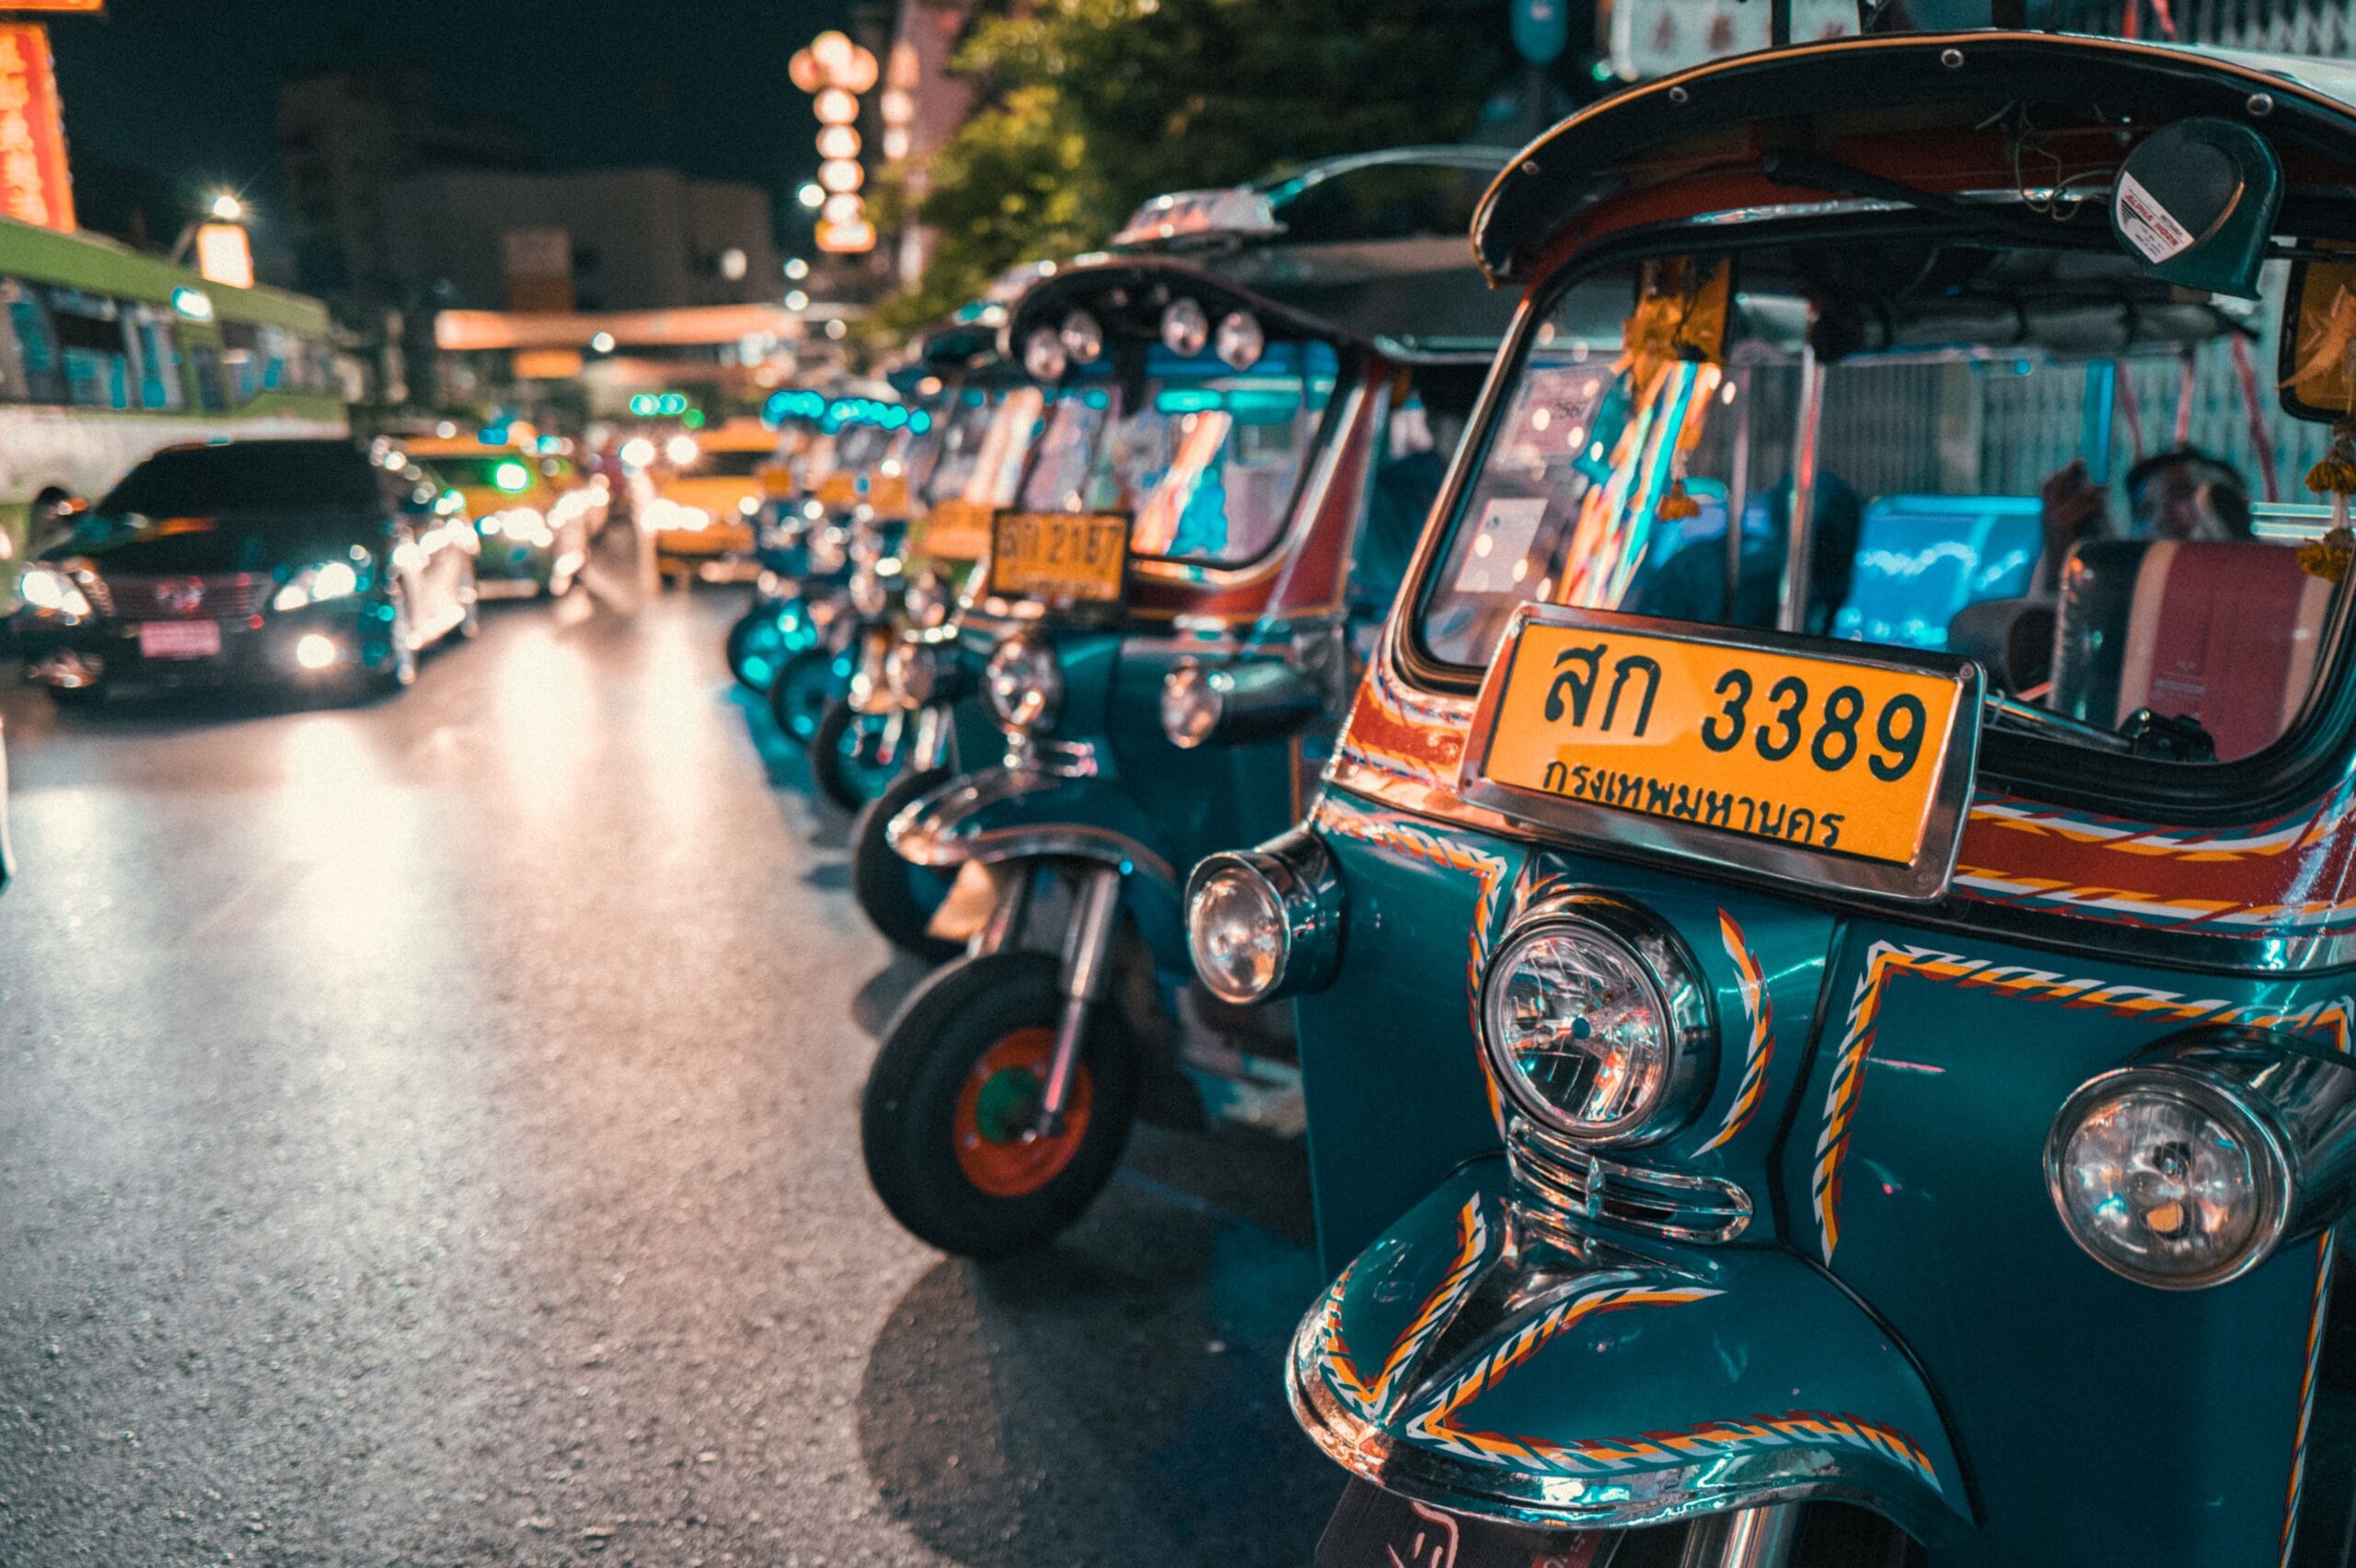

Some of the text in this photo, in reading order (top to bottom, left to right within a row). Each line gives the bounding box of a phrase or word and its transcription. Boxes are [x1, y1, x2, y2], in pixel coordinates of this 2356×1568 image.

[1544, 644, 1926, 781] สก 3389
[1542, 761, 1845, 847] กรงเทพมหานคร
